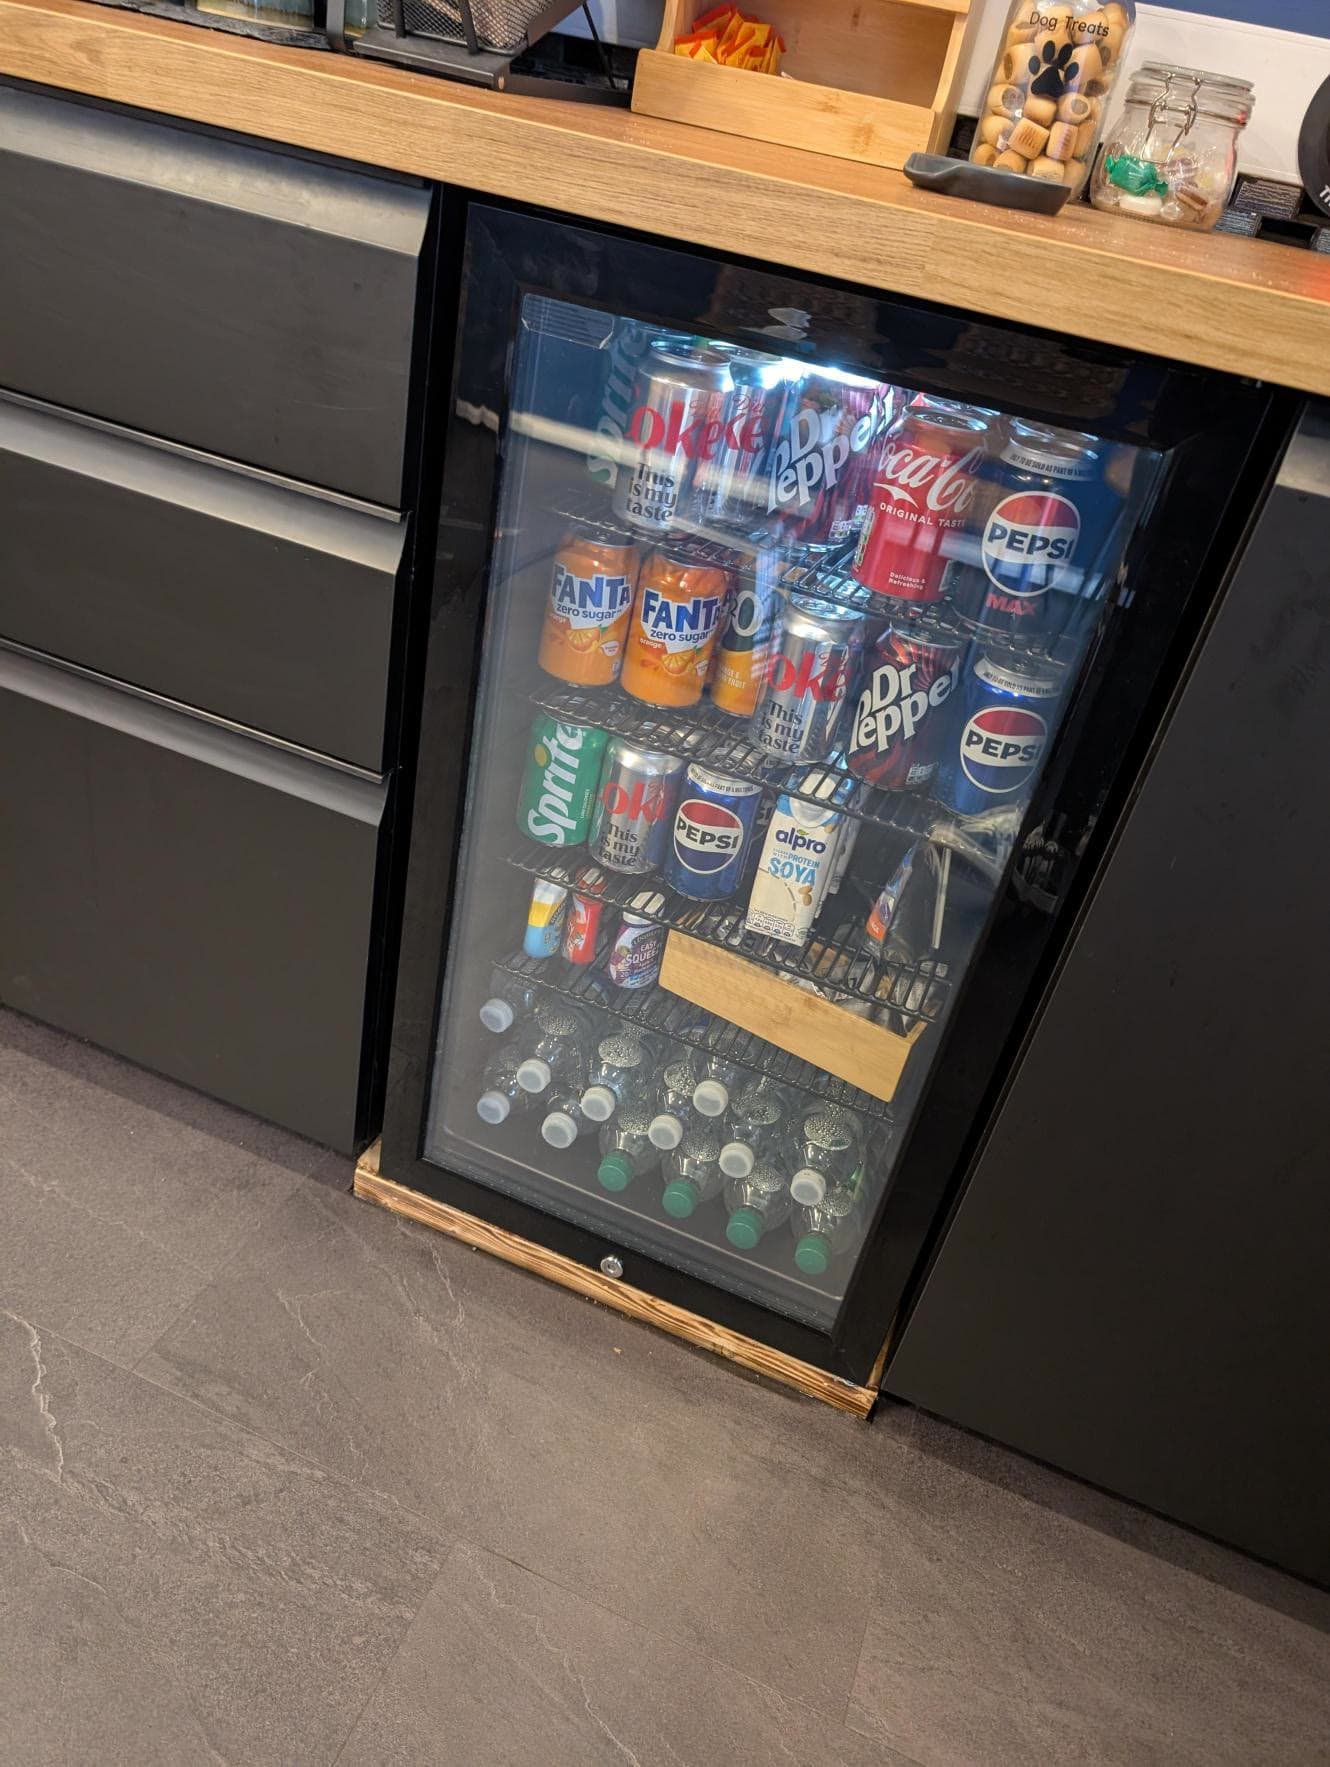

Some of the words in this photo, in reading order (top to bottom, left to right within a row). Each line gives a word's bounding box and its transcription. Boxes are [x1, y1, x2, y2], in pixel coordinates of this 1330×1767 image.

[1029, 11, 1058, 31] Dog
[1065, 15, 1110, 38] Treats
[626, 398, 724, 461] oke
[638, 463, 675, 487] This
[645, 485, 677, 508] my
[626, 498, 674, 521] taste
[879, 501, 934, 526] ORIGINAL
[987, 523, 1071, 560] PEPSI
[552, 563, 631, 611] FANTA
[888, 578, 924, 591] Refreshing
[889, 572, 920, 584] Delicious
[556, 602, 580, 618] zero
[581, 607, 616, 622] sugar
[986, 592, 1037, 616] MAX
[639, 637, 663, 649] orange
[650, 629, 676, 641] zero
[678, 632, 714, 646] sugar
[872, 663, 917, 706] Dr
[760, 711, 772, 730] is
[768, 699, 803, 724] This
[759, 729, 801, 754] taste
[774, 722, 804, 743] my
[965, 729, 1043, 762] PEPSI
[527, 723, 585, 845] Sprite
[607, 822, 639, 842] This
[676, 818, 738, 850] PEPSI
[775, 827, 827, 854] alpro
[614, 842, 640, 857] my
[788, 852, 820, 869] PROTEIN
[768, 857, 816, 886] SOYA
